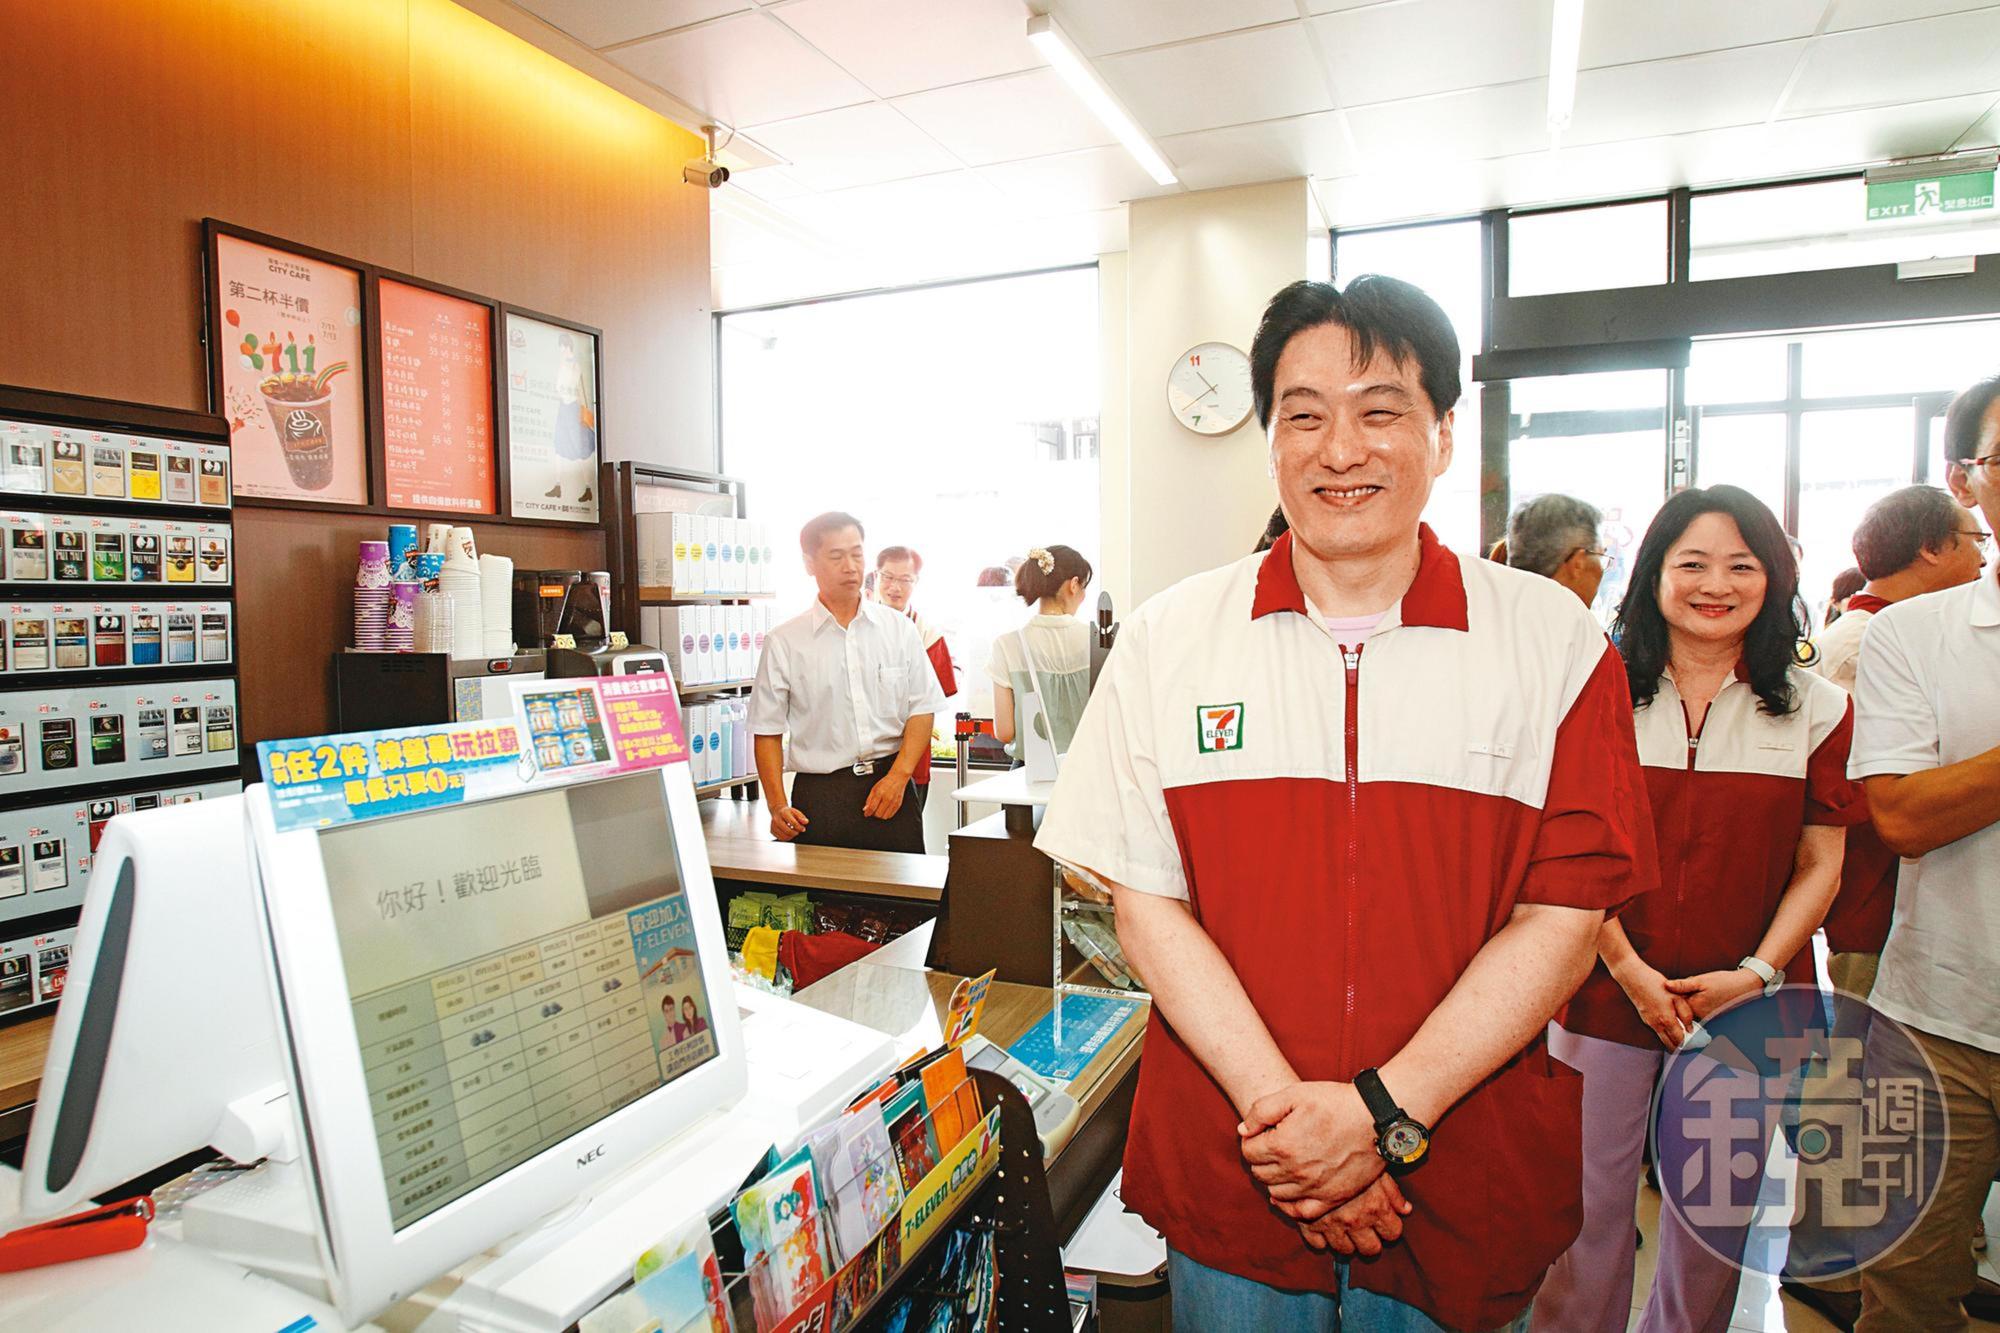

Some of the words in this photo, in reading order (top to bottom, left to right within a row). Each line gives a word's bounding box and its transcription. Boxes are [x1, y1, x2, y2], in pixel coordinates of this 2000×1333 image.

[1944, 195, 1993, 210] 緊急出口
[1868, 204, 1910, 218] EXIT
[268, 265, 287, 275] CITY
[289, 270, 311, 282] CAFE
[229, 280, 310, 314] 第二杯半價
[1190, 355, 1200, 366] 11
[1192, 415, 1201, 426] 7
[541, 503, 556, 511] CAFE
[577, 1143, 606, 1169] NEC
